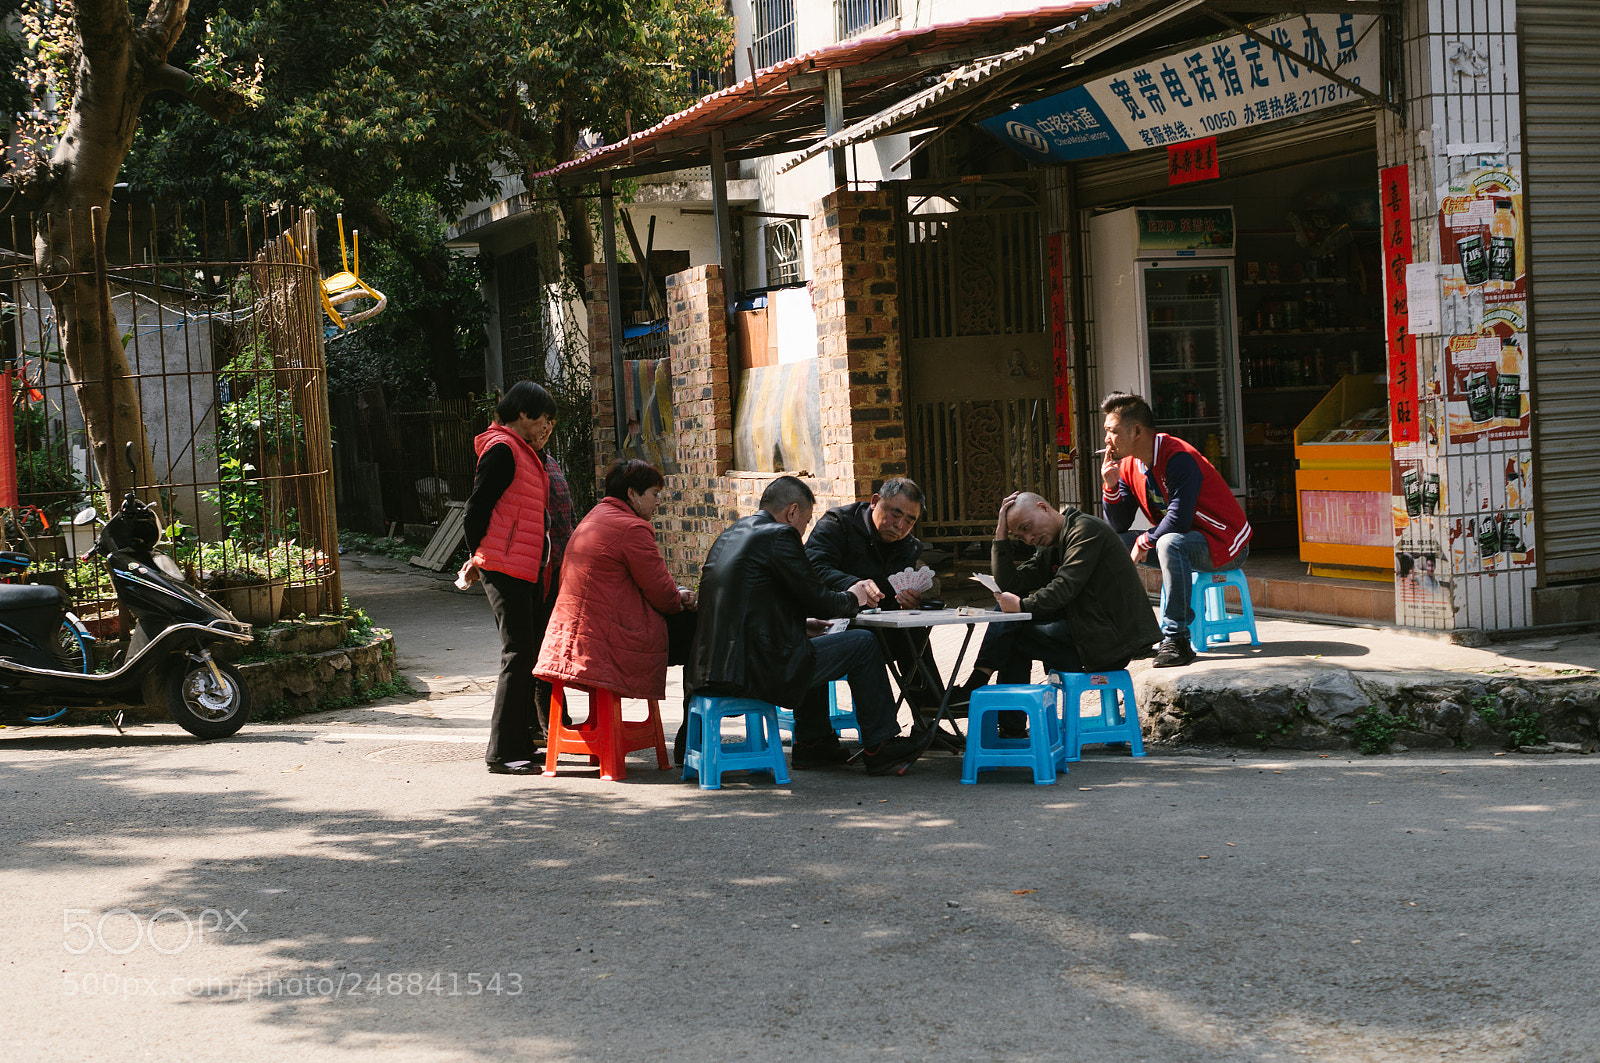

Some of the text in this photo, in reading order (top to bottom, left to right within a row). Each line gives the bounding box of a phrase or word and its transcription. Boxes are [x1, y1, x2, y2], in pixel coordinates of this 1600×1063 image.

[1108, 13, 1358, 122] 宽带电话指定代办点
[1036, 106, 1100, 137] 中移铁通
[1199, 110, 1238, 134] 10050
